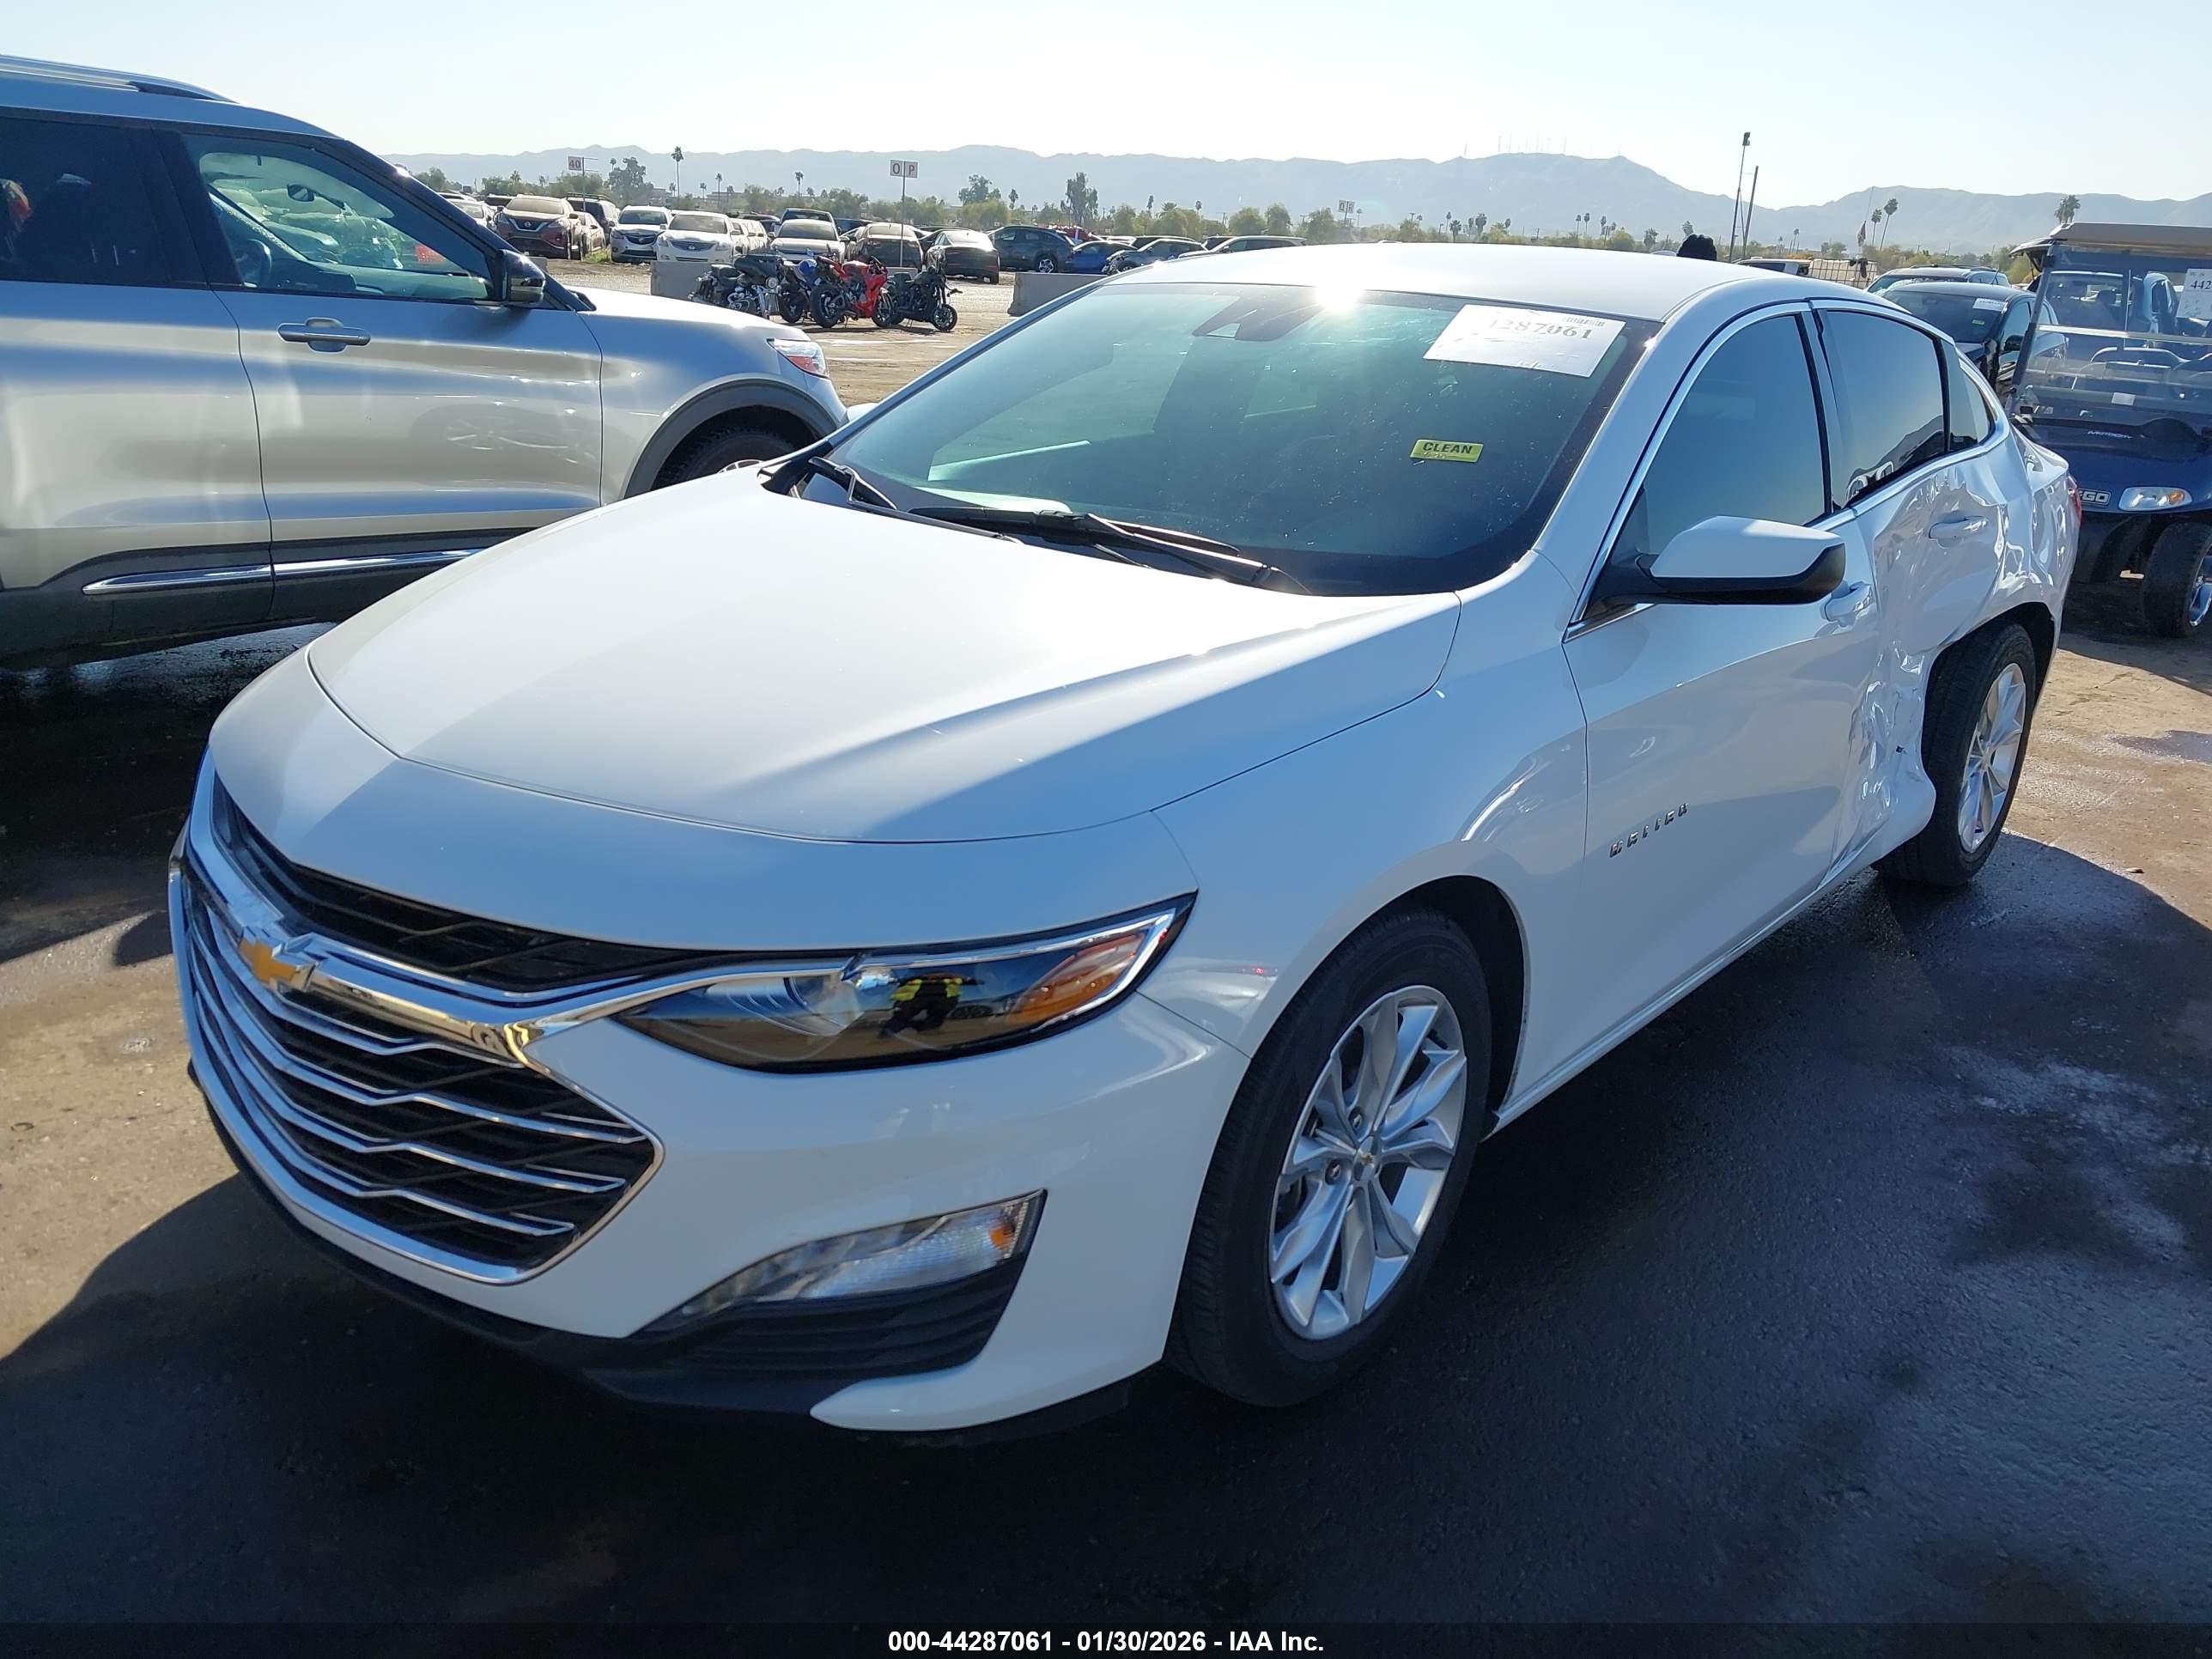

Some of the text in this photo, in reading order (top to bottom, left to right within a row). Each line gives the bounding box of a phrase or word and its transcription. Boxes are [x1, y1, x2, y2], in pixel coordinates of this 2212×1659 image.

[568, 159, 581, 169] 40
[908, 164, 915, 175] P
[1422, 441, 1473, 454] CLEAN
